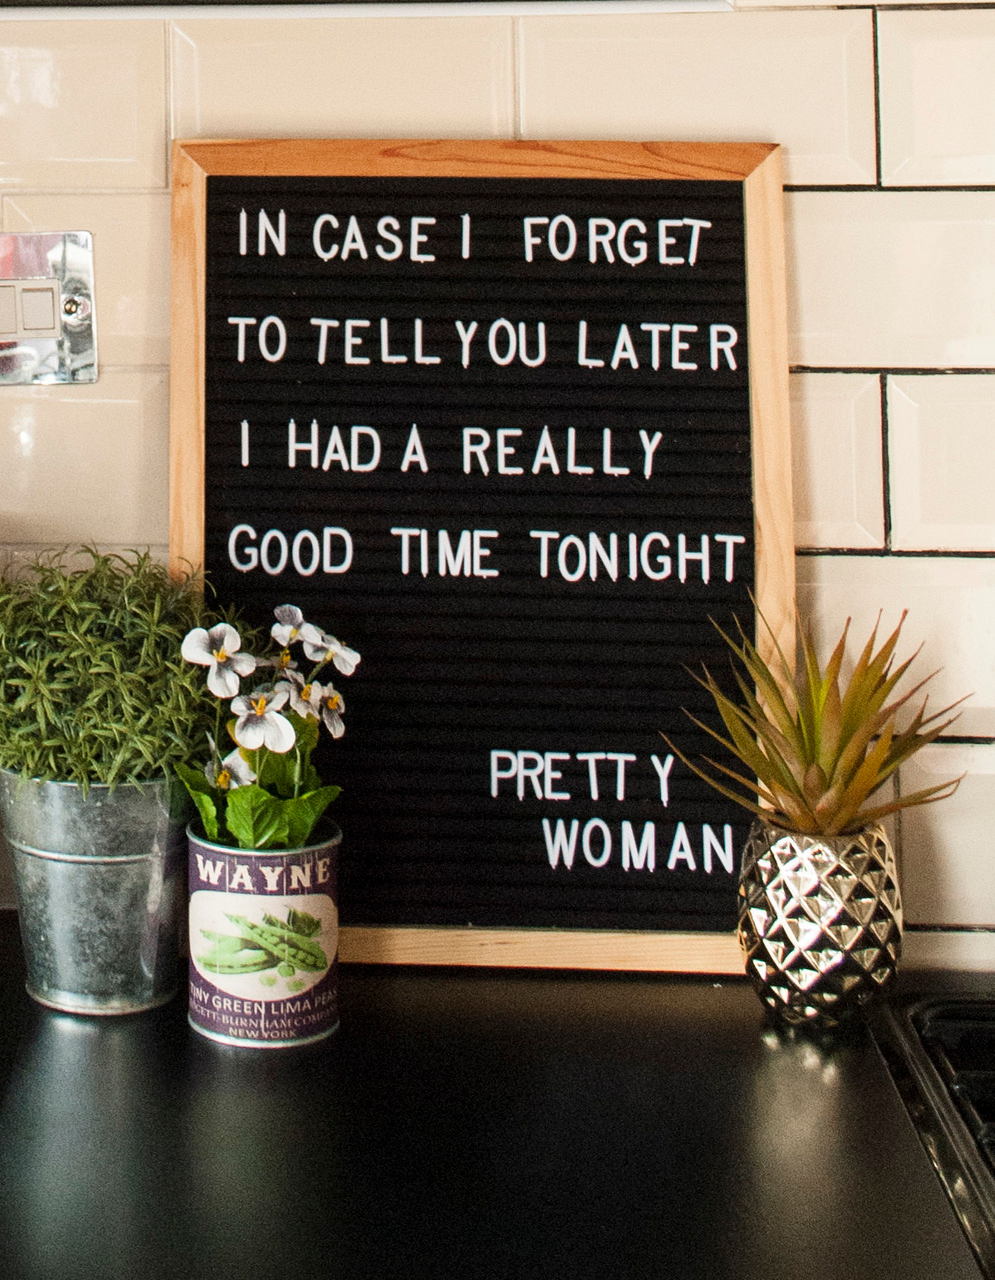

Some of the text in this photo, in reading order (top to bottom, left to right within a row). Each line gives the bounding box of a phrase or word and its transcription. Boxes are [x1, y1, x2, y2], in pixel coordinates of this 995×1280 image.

[240, 209, 711, 266] IN CASE I FORGET
[228, 316, 737, 370] TO TELL YOU LATER
[241, 419, 662, 479] I HAD A REALLY
[229, 525, 745, 584] GOOD TIME TONIGHT
[491, 751, 673, 806] PRETTY
[196, 854, 331, 892] WAYNE
[543, 818, 733, 873] WOMAN
[212, 996, 265, 1016] GREEN
[271, 1000, 311, 1014] LIMA
[229, 1027, 296, 1039] NEW YORK
